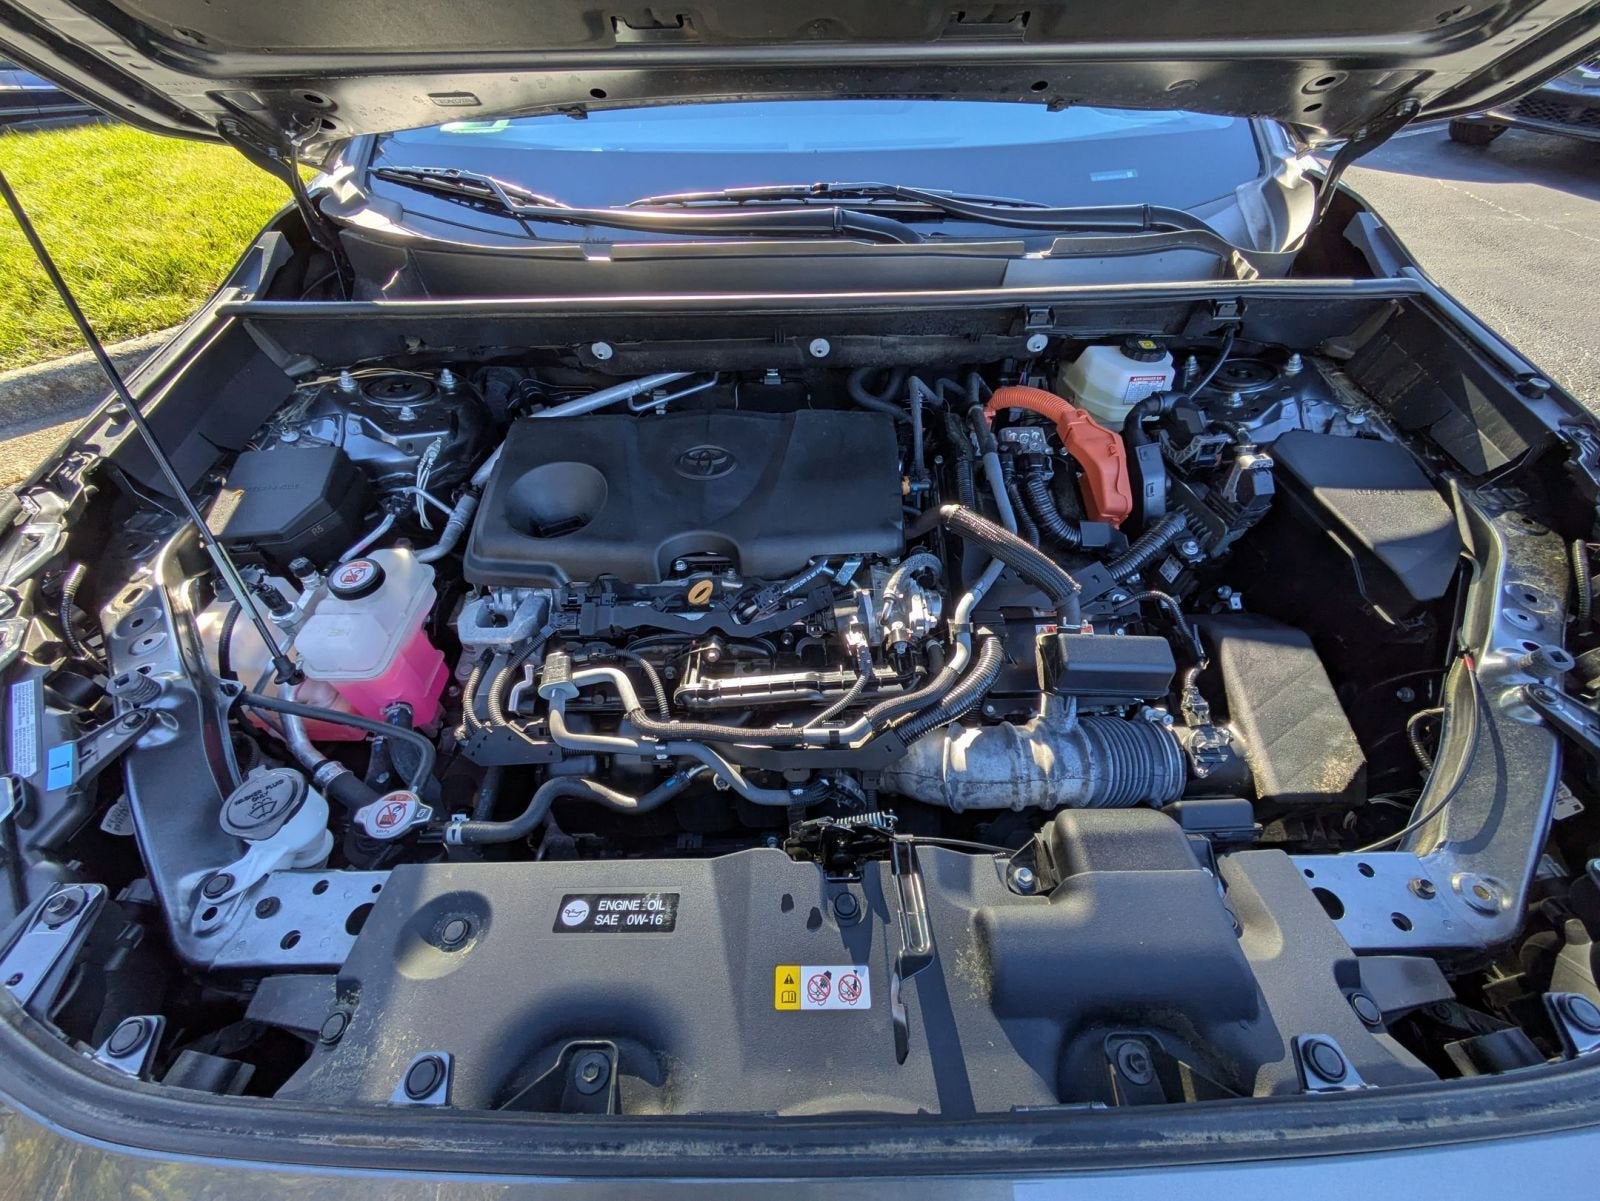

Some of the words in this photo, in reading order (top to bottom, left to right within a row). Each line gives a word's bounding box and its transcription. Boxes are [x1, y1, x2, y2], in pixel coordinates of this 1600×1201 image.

[311, 525, 325, 537] R5
[265, 779, 285, 790] FLUID
[251, 791, 269, 802] ONLY
[598, 900, 641, 911] ENGINE
[647, 900, 666, 911] OIL
[594, 914, 620, 925] SAE
[626, 914, 664, 925] 0W-16
